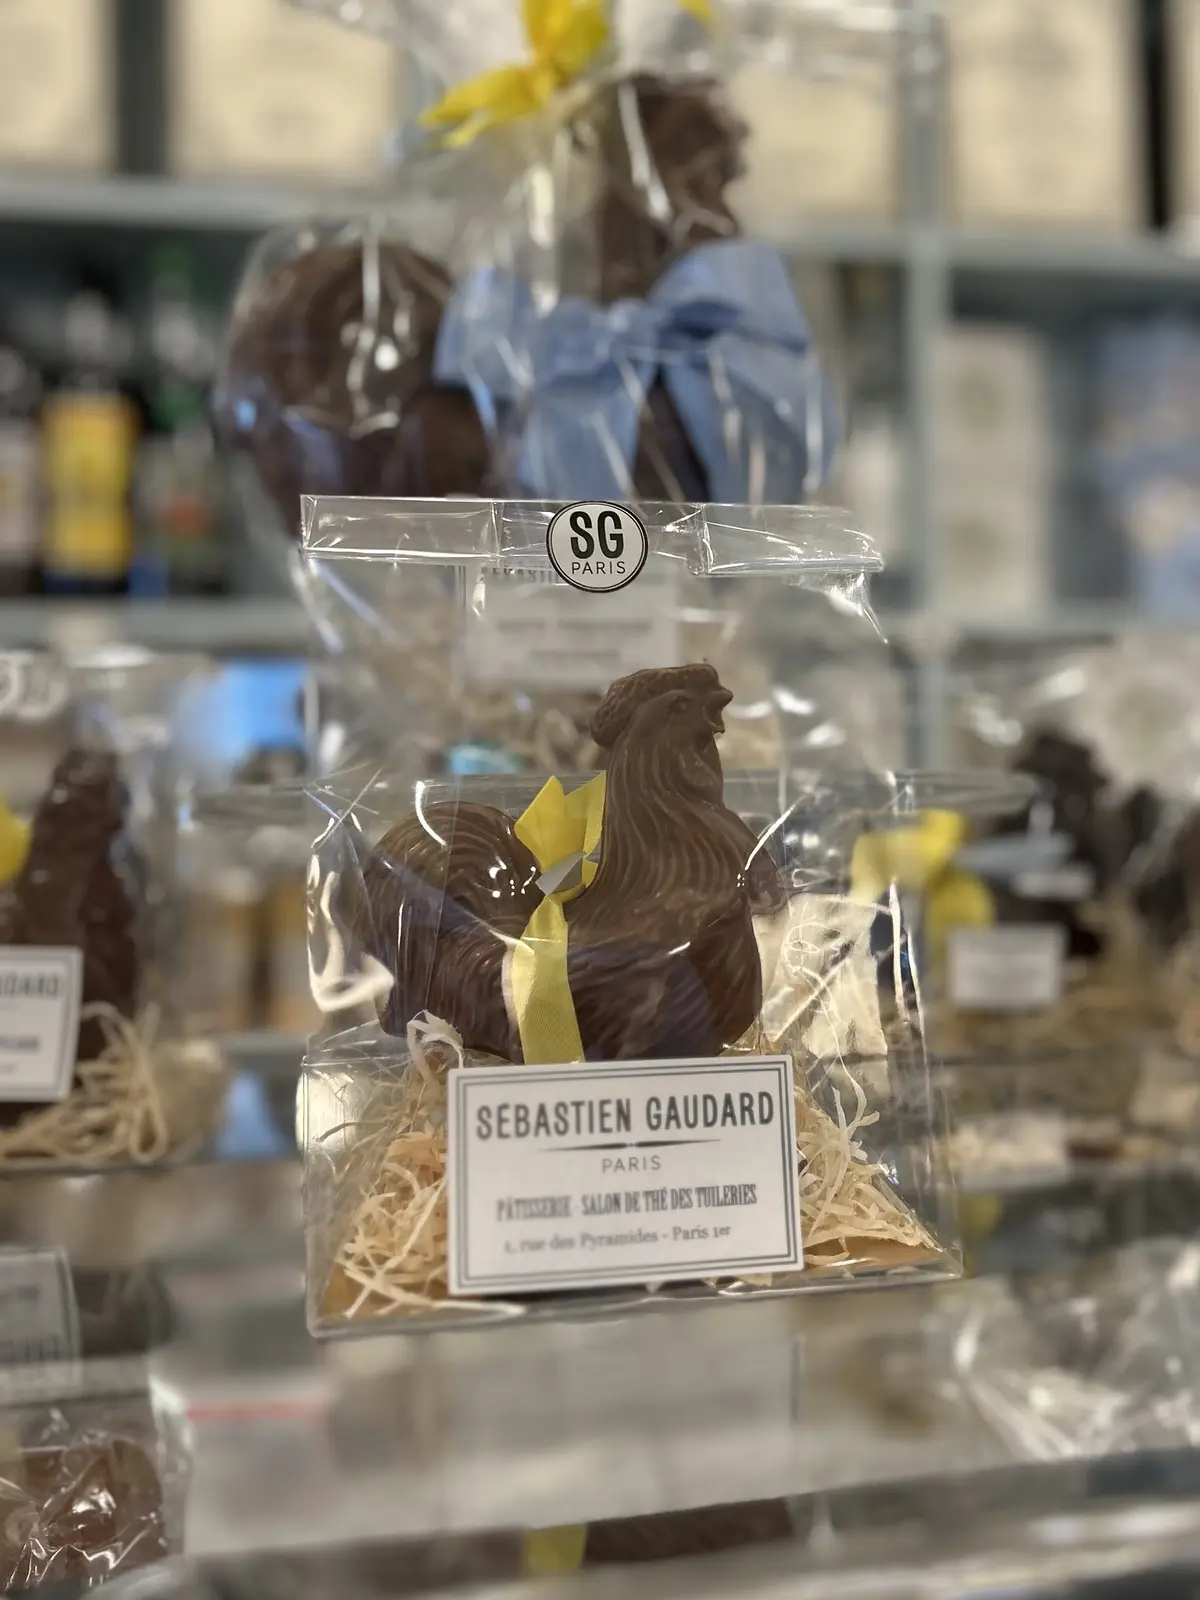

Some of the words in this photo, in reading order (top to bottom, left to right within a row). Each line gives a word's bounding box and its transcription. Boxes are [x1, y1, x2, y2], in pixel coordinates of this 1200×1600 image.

[569, 510, 624, 559] SG
[571, 561, 626, 575] PARIS
[645, 1091, 774, 1131] GAUDARD
[601, 1155, 661, 1173] PARIS
[581, 1191, 622, 1216] SALON
[624, 1191, 640, 1214] DE
[643, 1187, 668, 1212] THÉ
[670, 1188, 693, 1210] DES
[695, 1184, 758, 1208] TUILERIES
[580, 1227, 658, 1252] Pyramides
[672, 1225, 709, 1241] Paris
